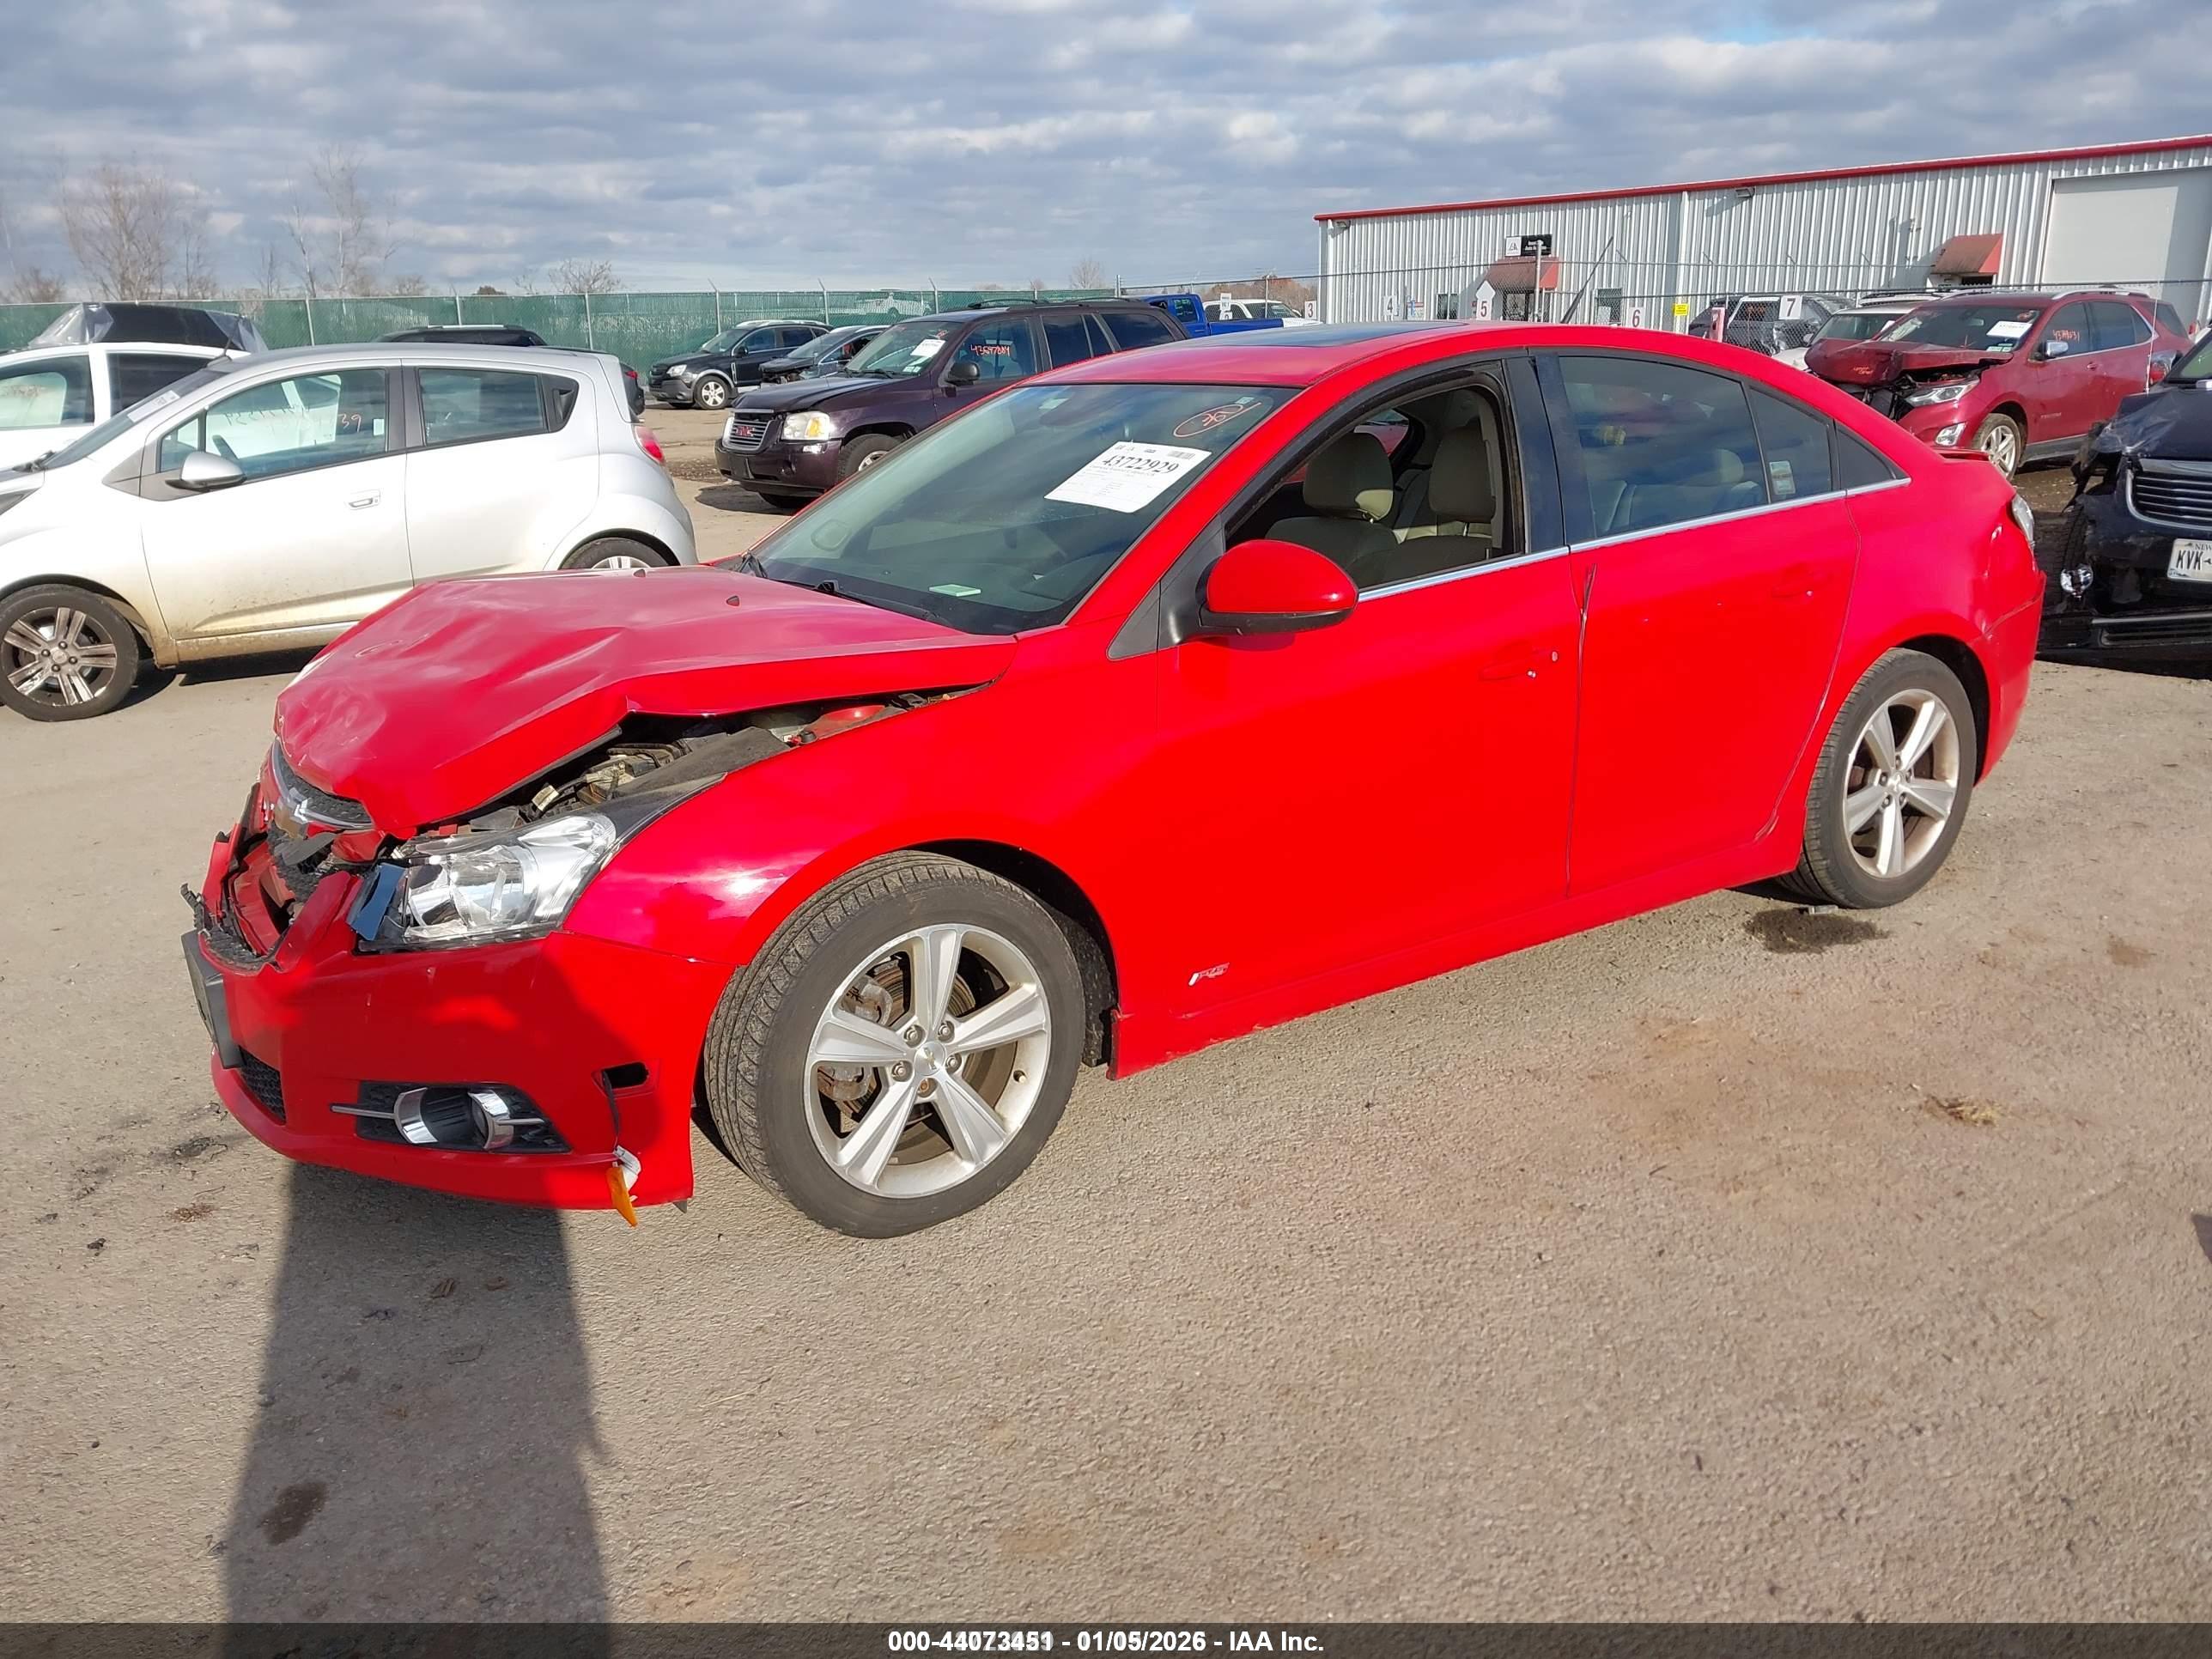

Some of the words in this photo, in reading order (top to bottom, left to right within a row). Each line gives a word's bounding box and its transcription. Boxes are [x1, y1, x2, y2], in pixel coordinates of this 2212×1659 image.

[1308, 302, 1314, 318] 3
[1387, 298, 1394, 315] 4
[1480, 301, 1487, 317] 5
[1786, 298, 1796, 317] 7
[1632, 310, 1640, 327] 6
[1102, 454, 1180, 474] 43722929
